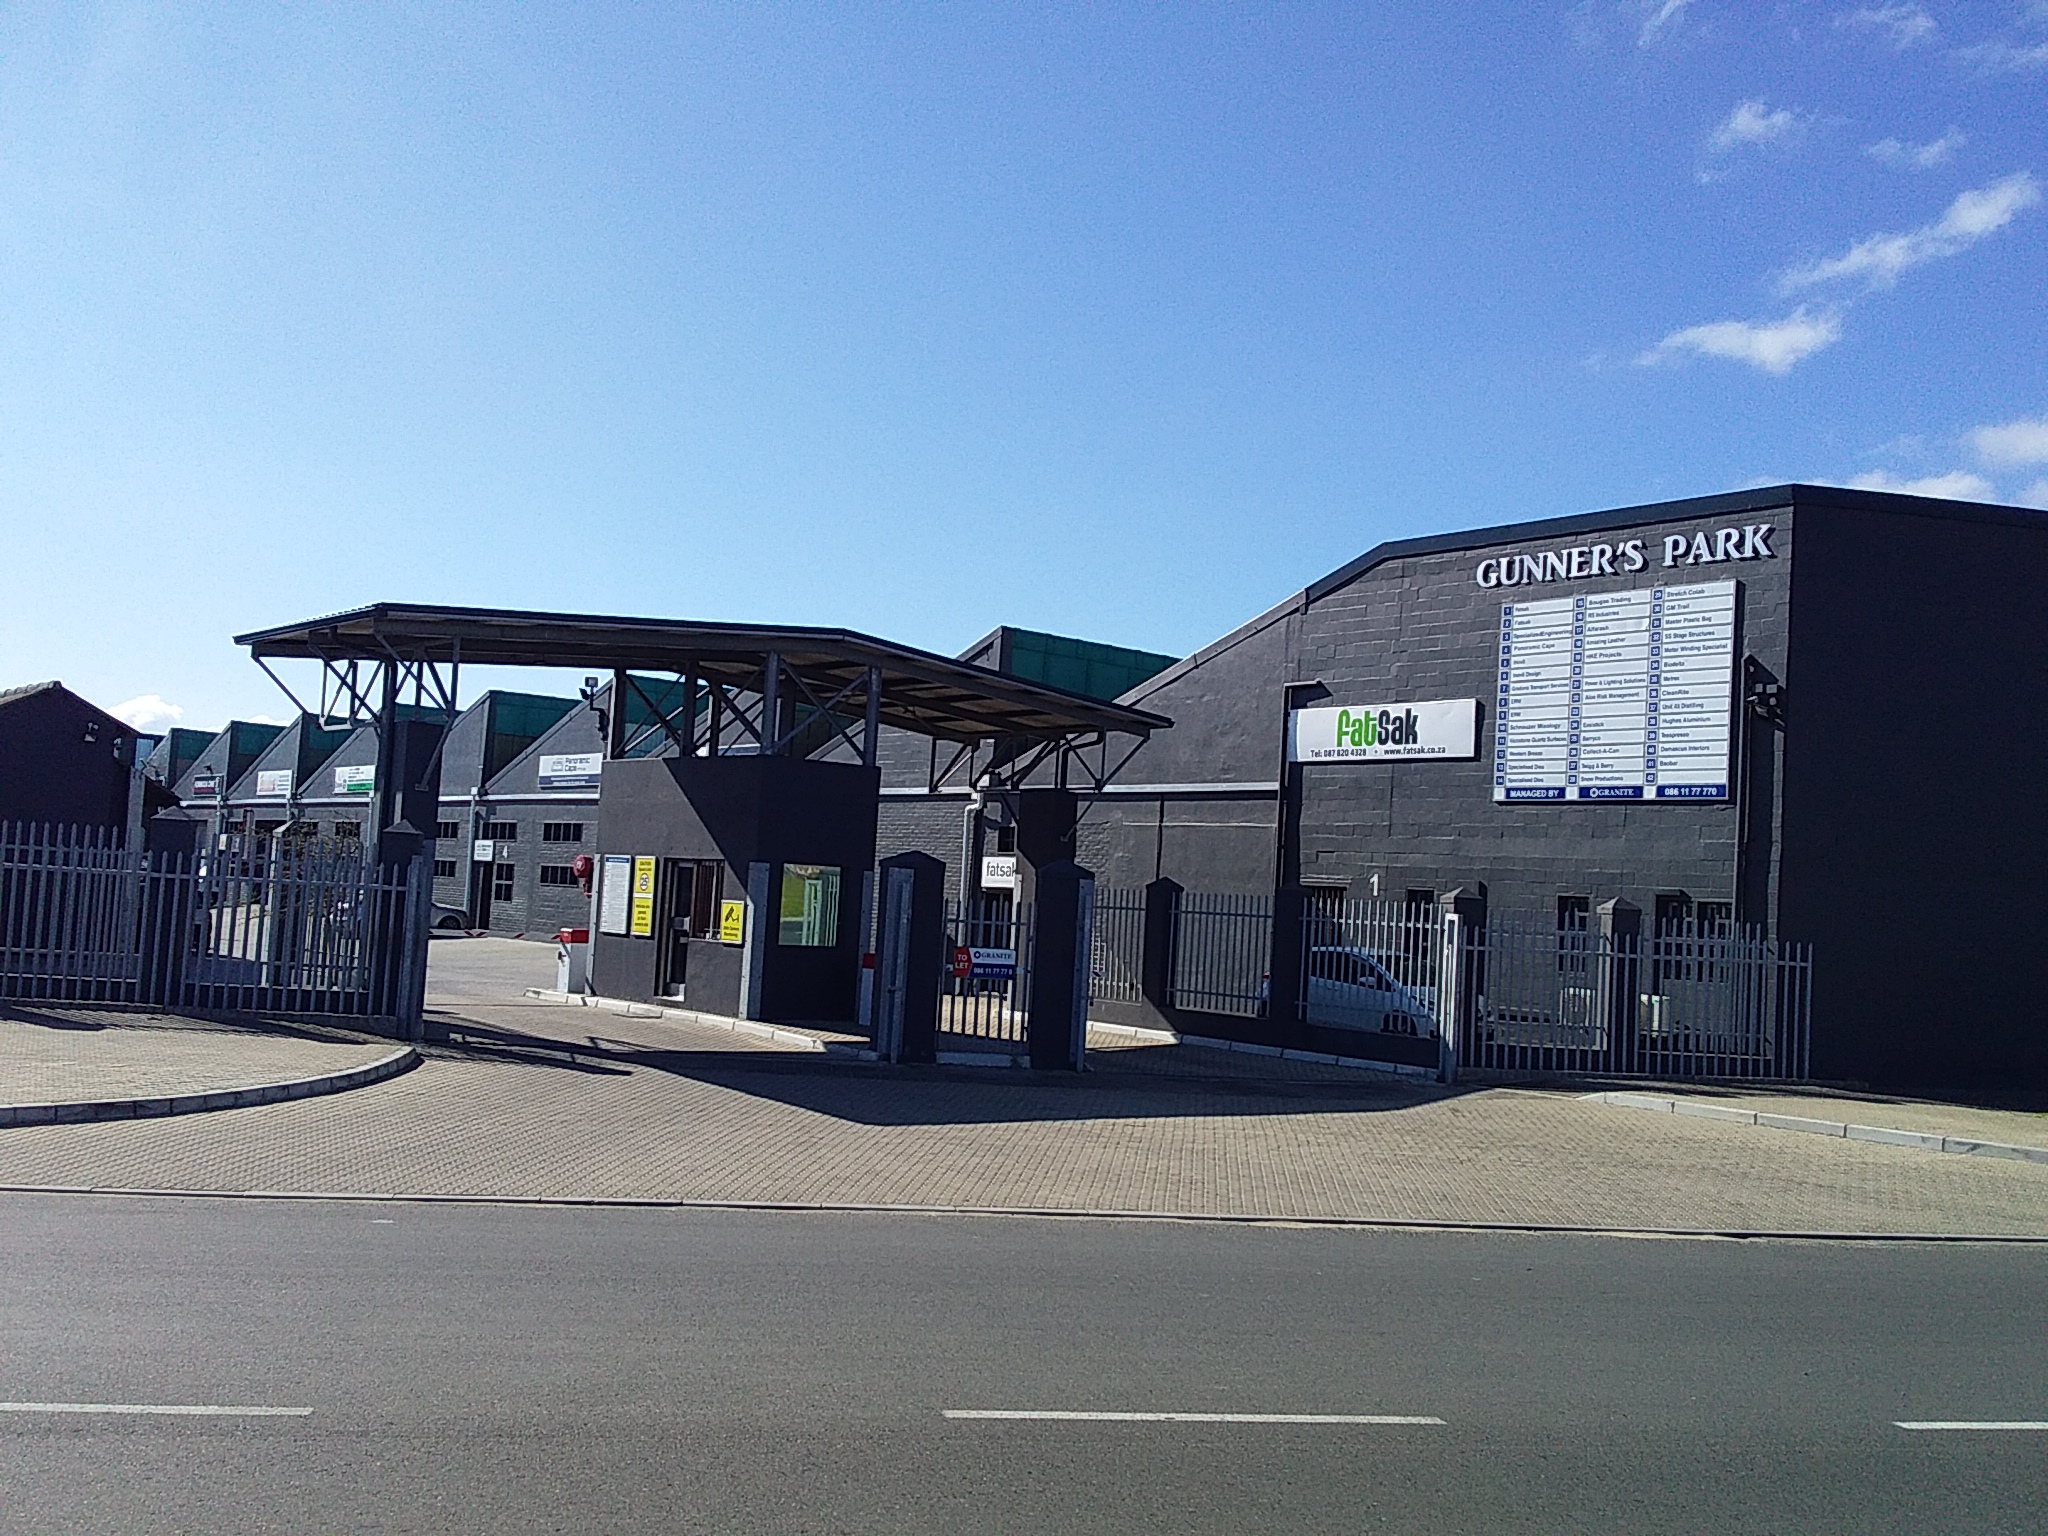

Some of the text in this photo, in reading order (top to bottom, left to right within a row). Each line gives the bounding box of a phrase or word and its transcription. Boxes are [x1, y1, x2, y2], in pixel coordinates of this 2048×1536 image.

[1476, 523, 1773, 588] GUNNER'S PARK
[1666, 590, 1687, 598] Stretch
[1610, 596, 1632, 604] Trading
[1599, 651, 1622, 659] Projects
[1310, 746, 1446, 758] Tel: 087 820 4328 www.fatsak.co.za
[1509, 789, 1560, 798] MANAGED BY
[1599, 788, 1635, 796] GRANITE
[1664, 787, 1718, 796] 086 11 77 770
[1369, 873, 1379, 897] 1
